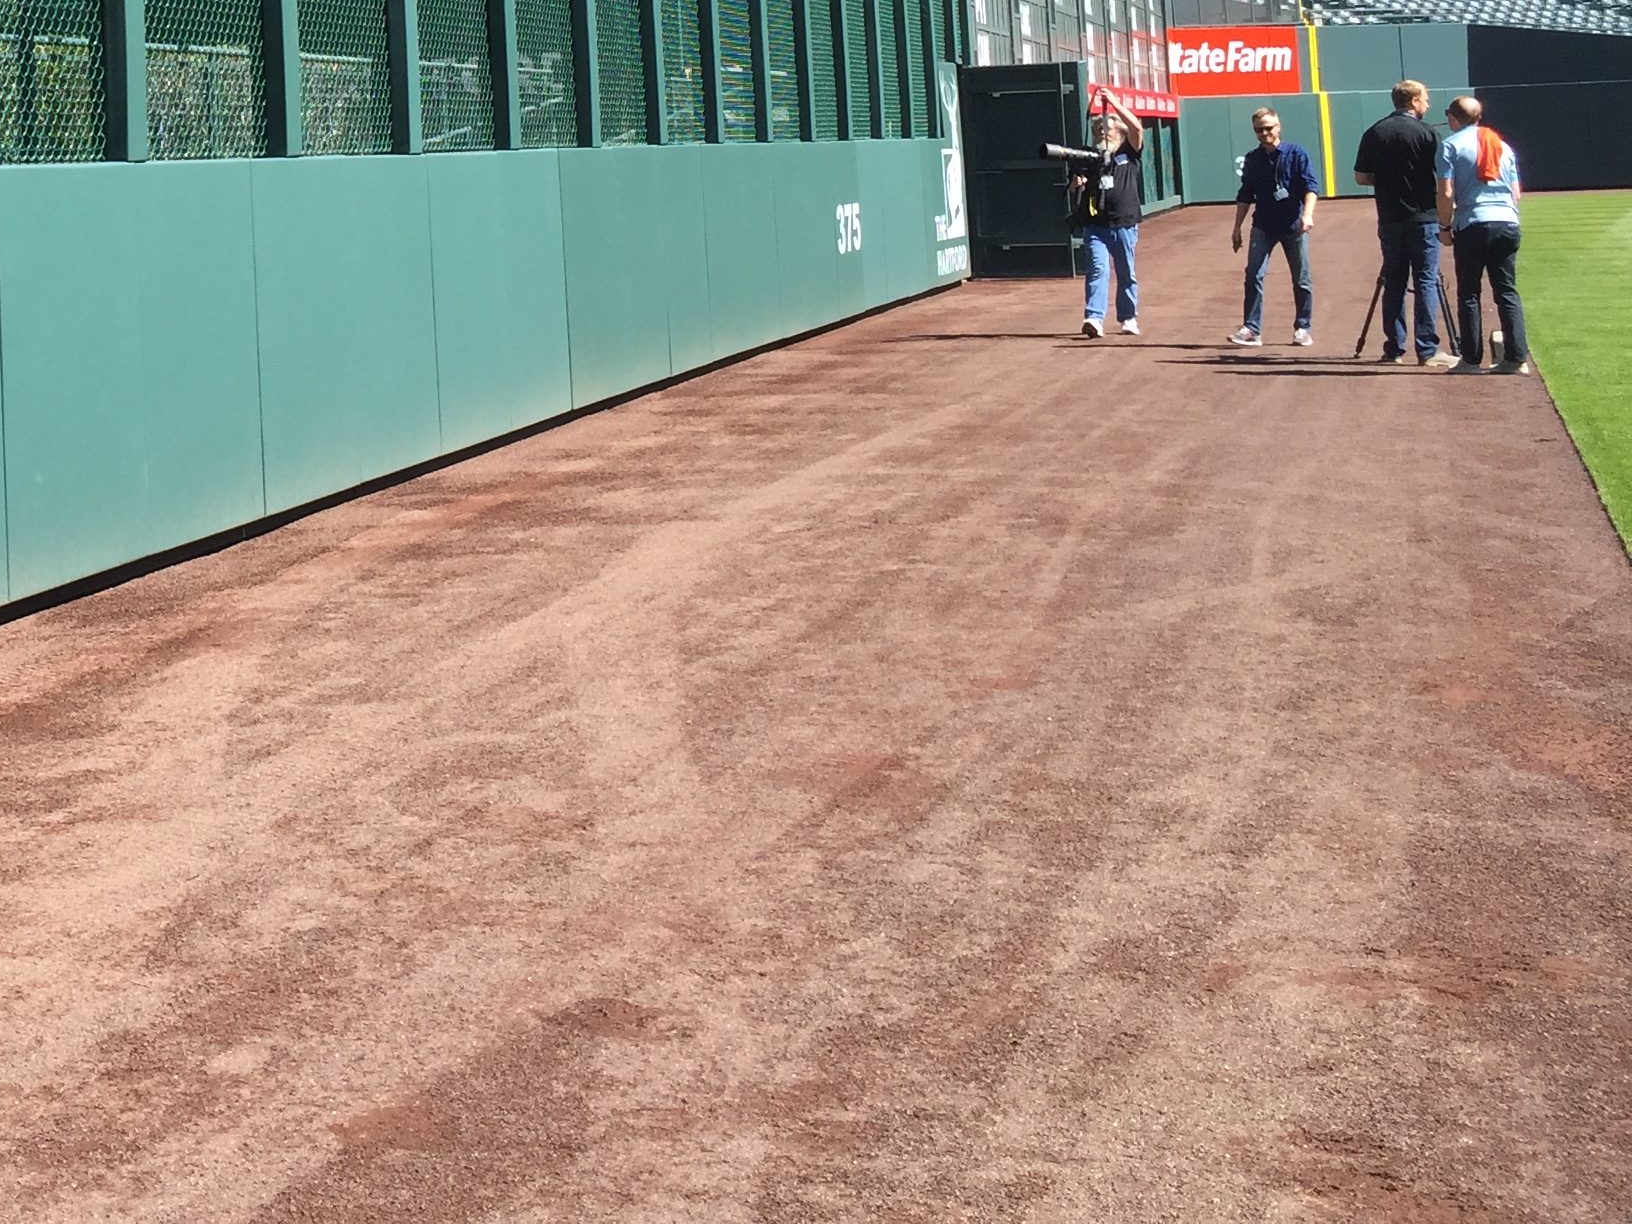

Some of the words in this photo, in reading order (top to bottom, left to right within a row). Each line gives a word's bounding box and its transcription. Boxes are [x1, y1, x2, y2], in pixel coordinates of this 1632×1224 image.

[836, 202, 862, 255] 375
[935, 214, 948, 242] THE
[937, 244, 967, 277] HARTFORD
